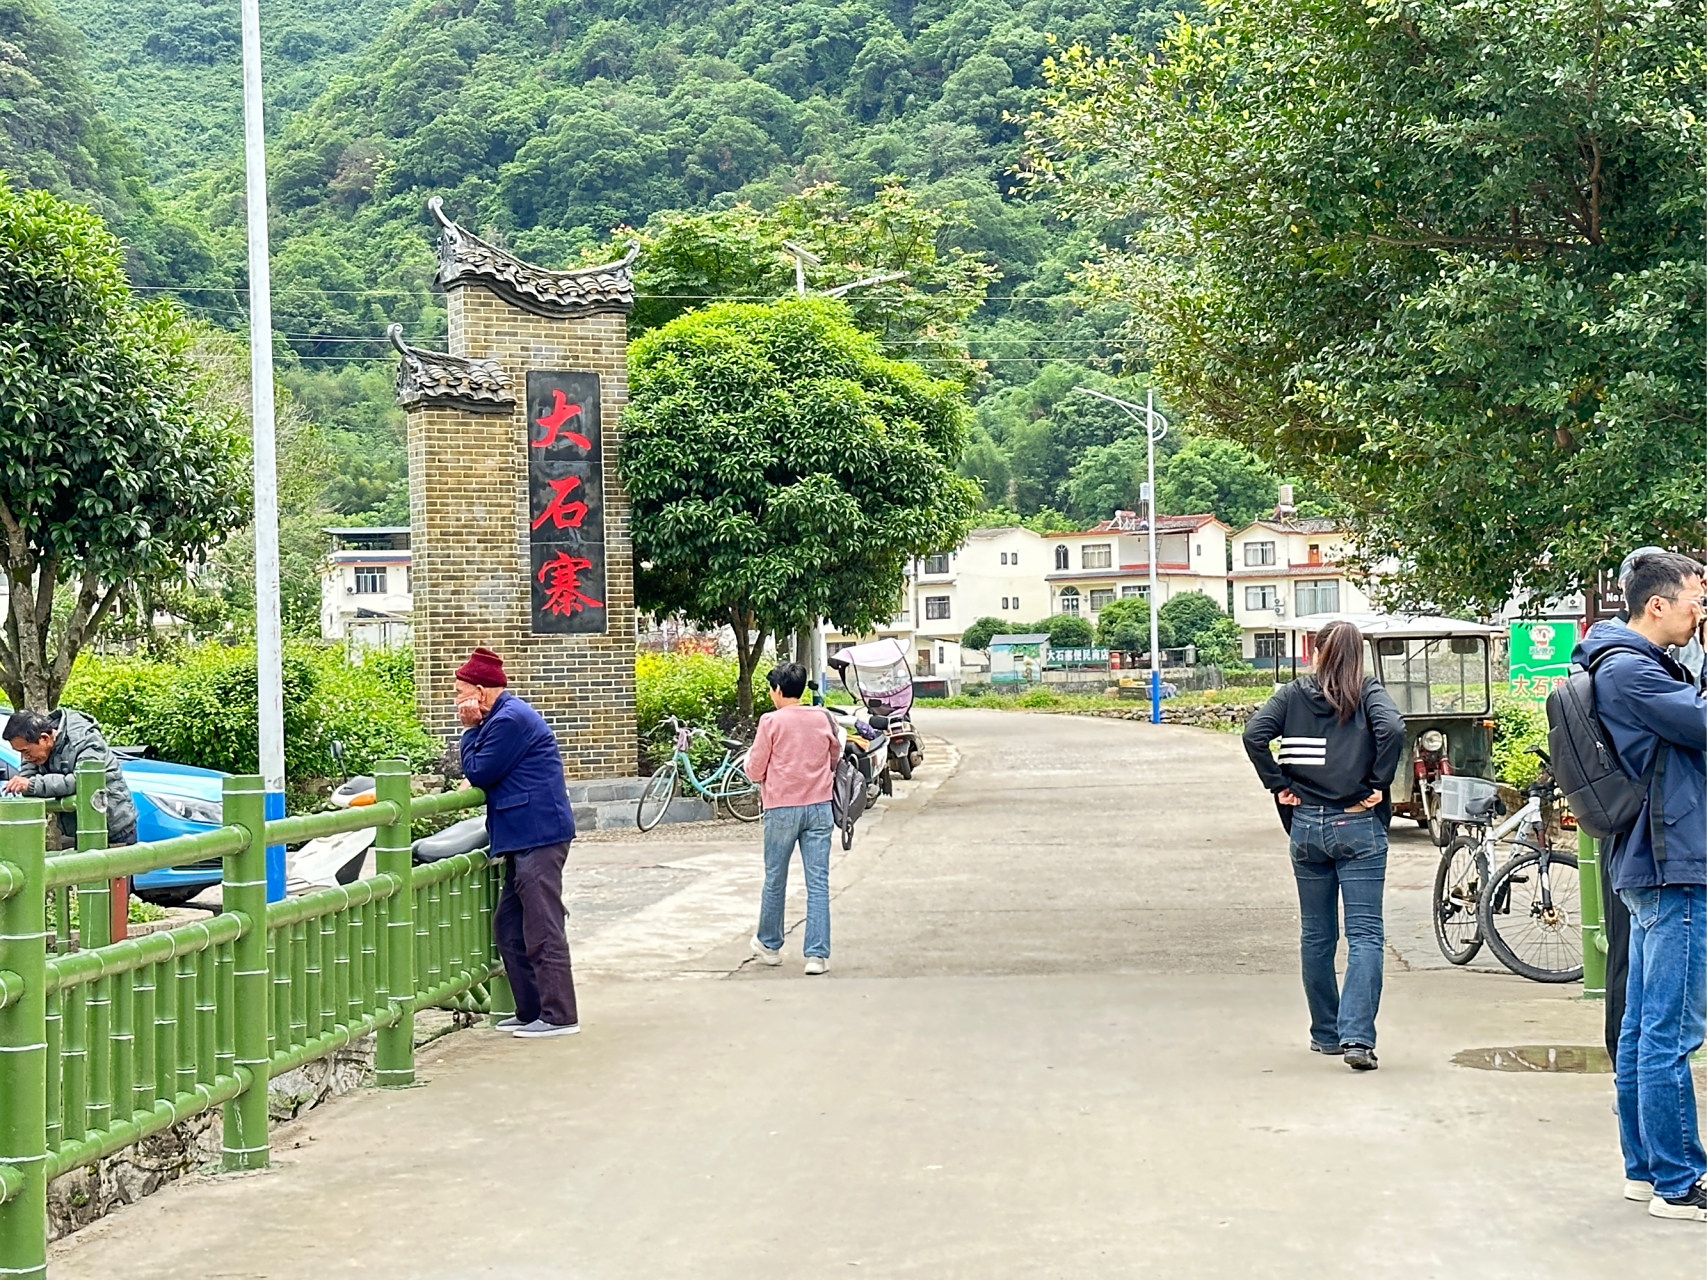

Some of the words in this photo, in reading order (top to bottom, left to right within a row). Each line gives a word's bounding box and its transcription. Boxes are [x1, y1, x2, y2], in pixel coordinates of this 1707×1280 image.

[531, 389, 604, 617] 大石寨
[1606, 592, 1619, 602] No
